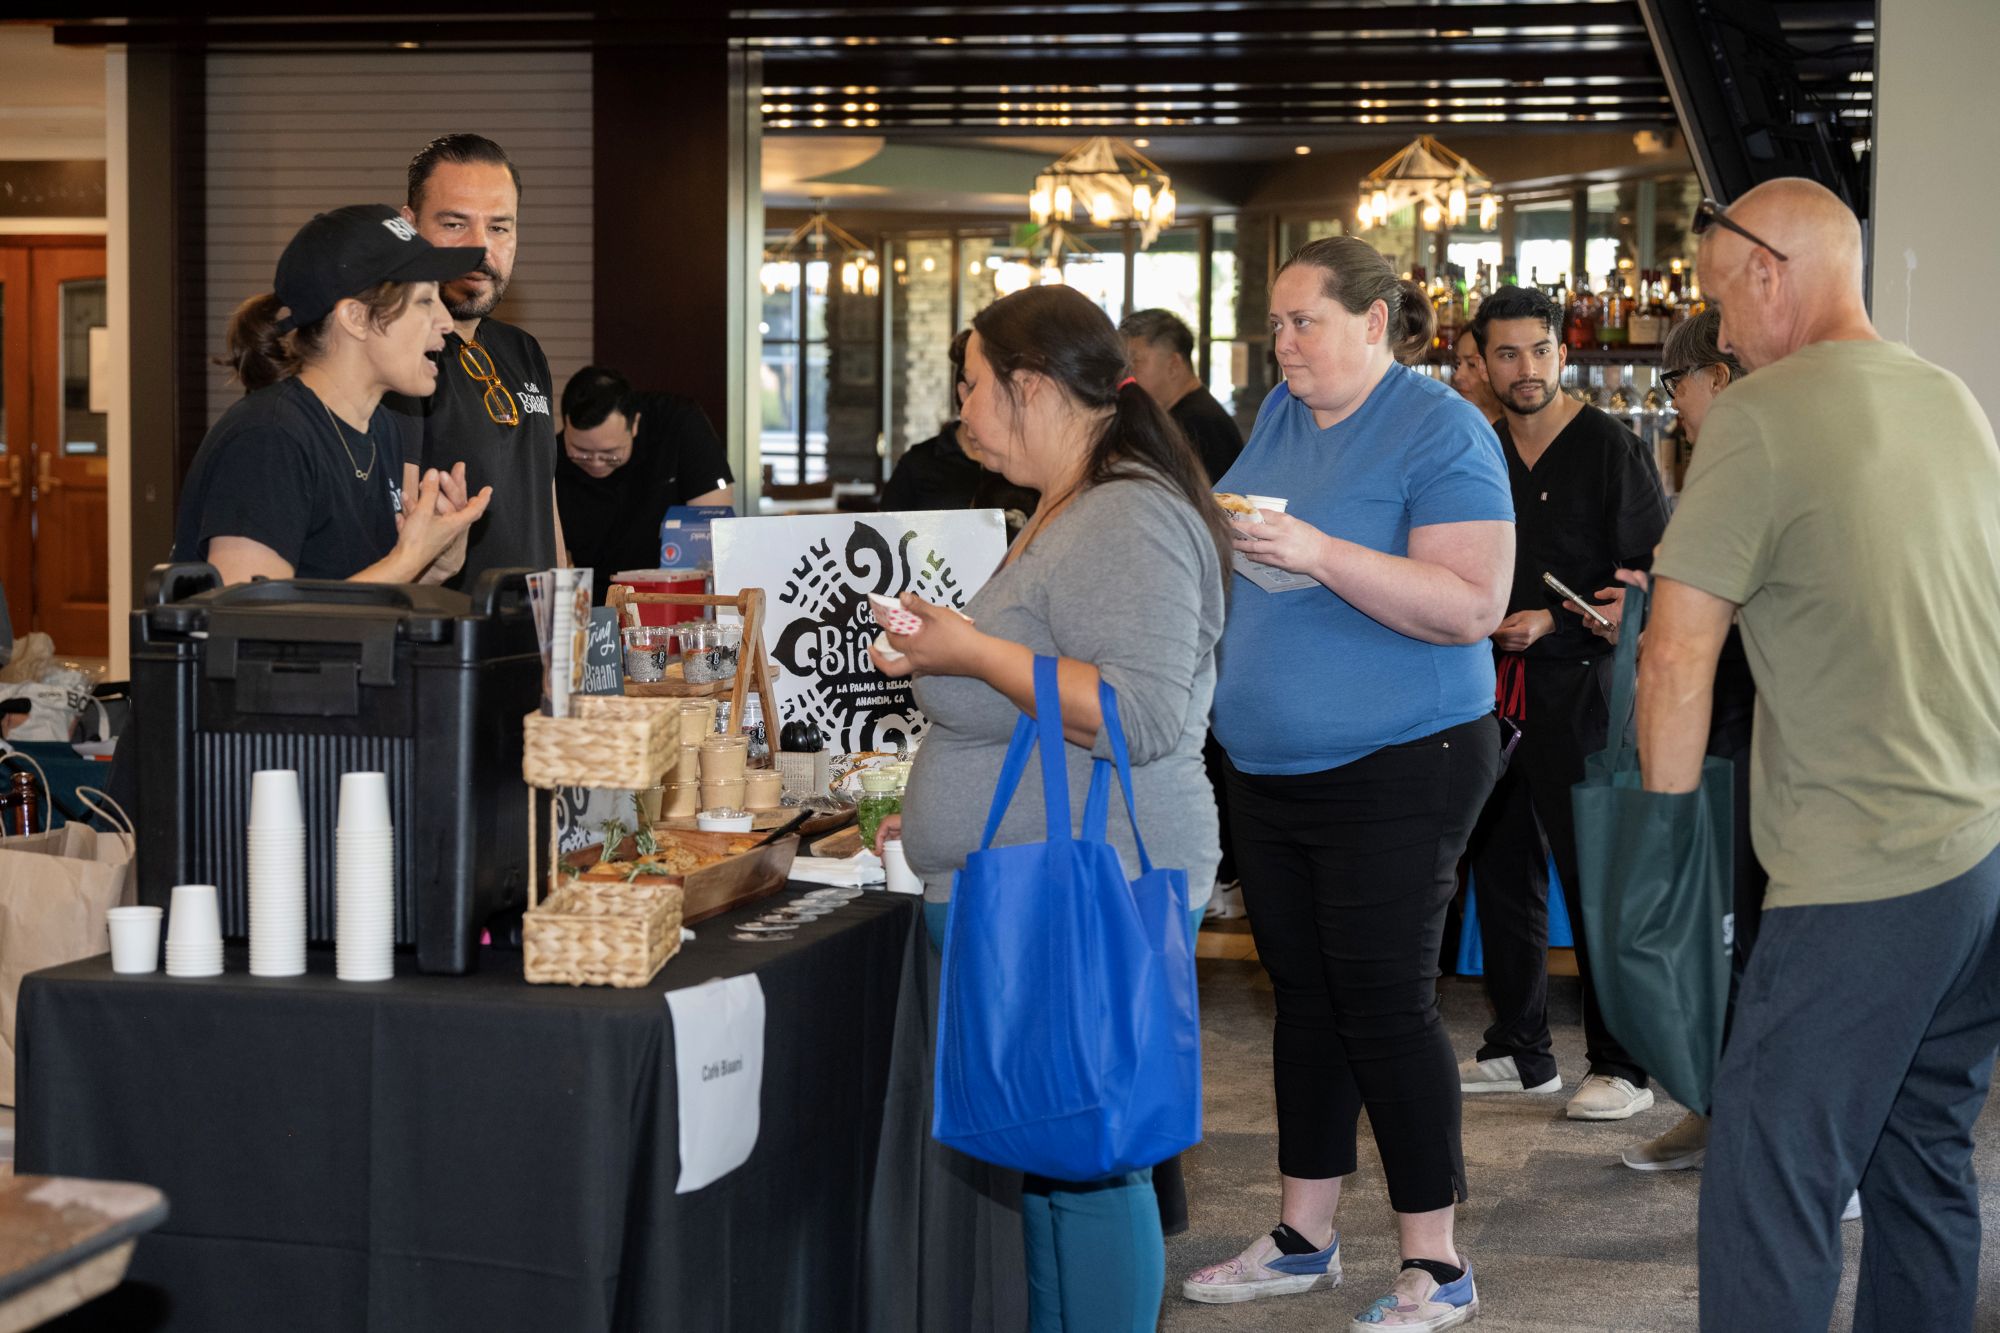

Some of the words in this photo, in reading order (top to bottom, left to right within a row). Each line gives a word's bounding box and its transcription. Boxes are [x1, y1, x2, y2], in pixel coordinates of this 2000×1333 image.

[836, 684, 848, 694] LA
[849, 681, 877, 694] PALMA
[855, 696, 893, 707] ANAHEIM,
[894, 694, 905, 704] CA
